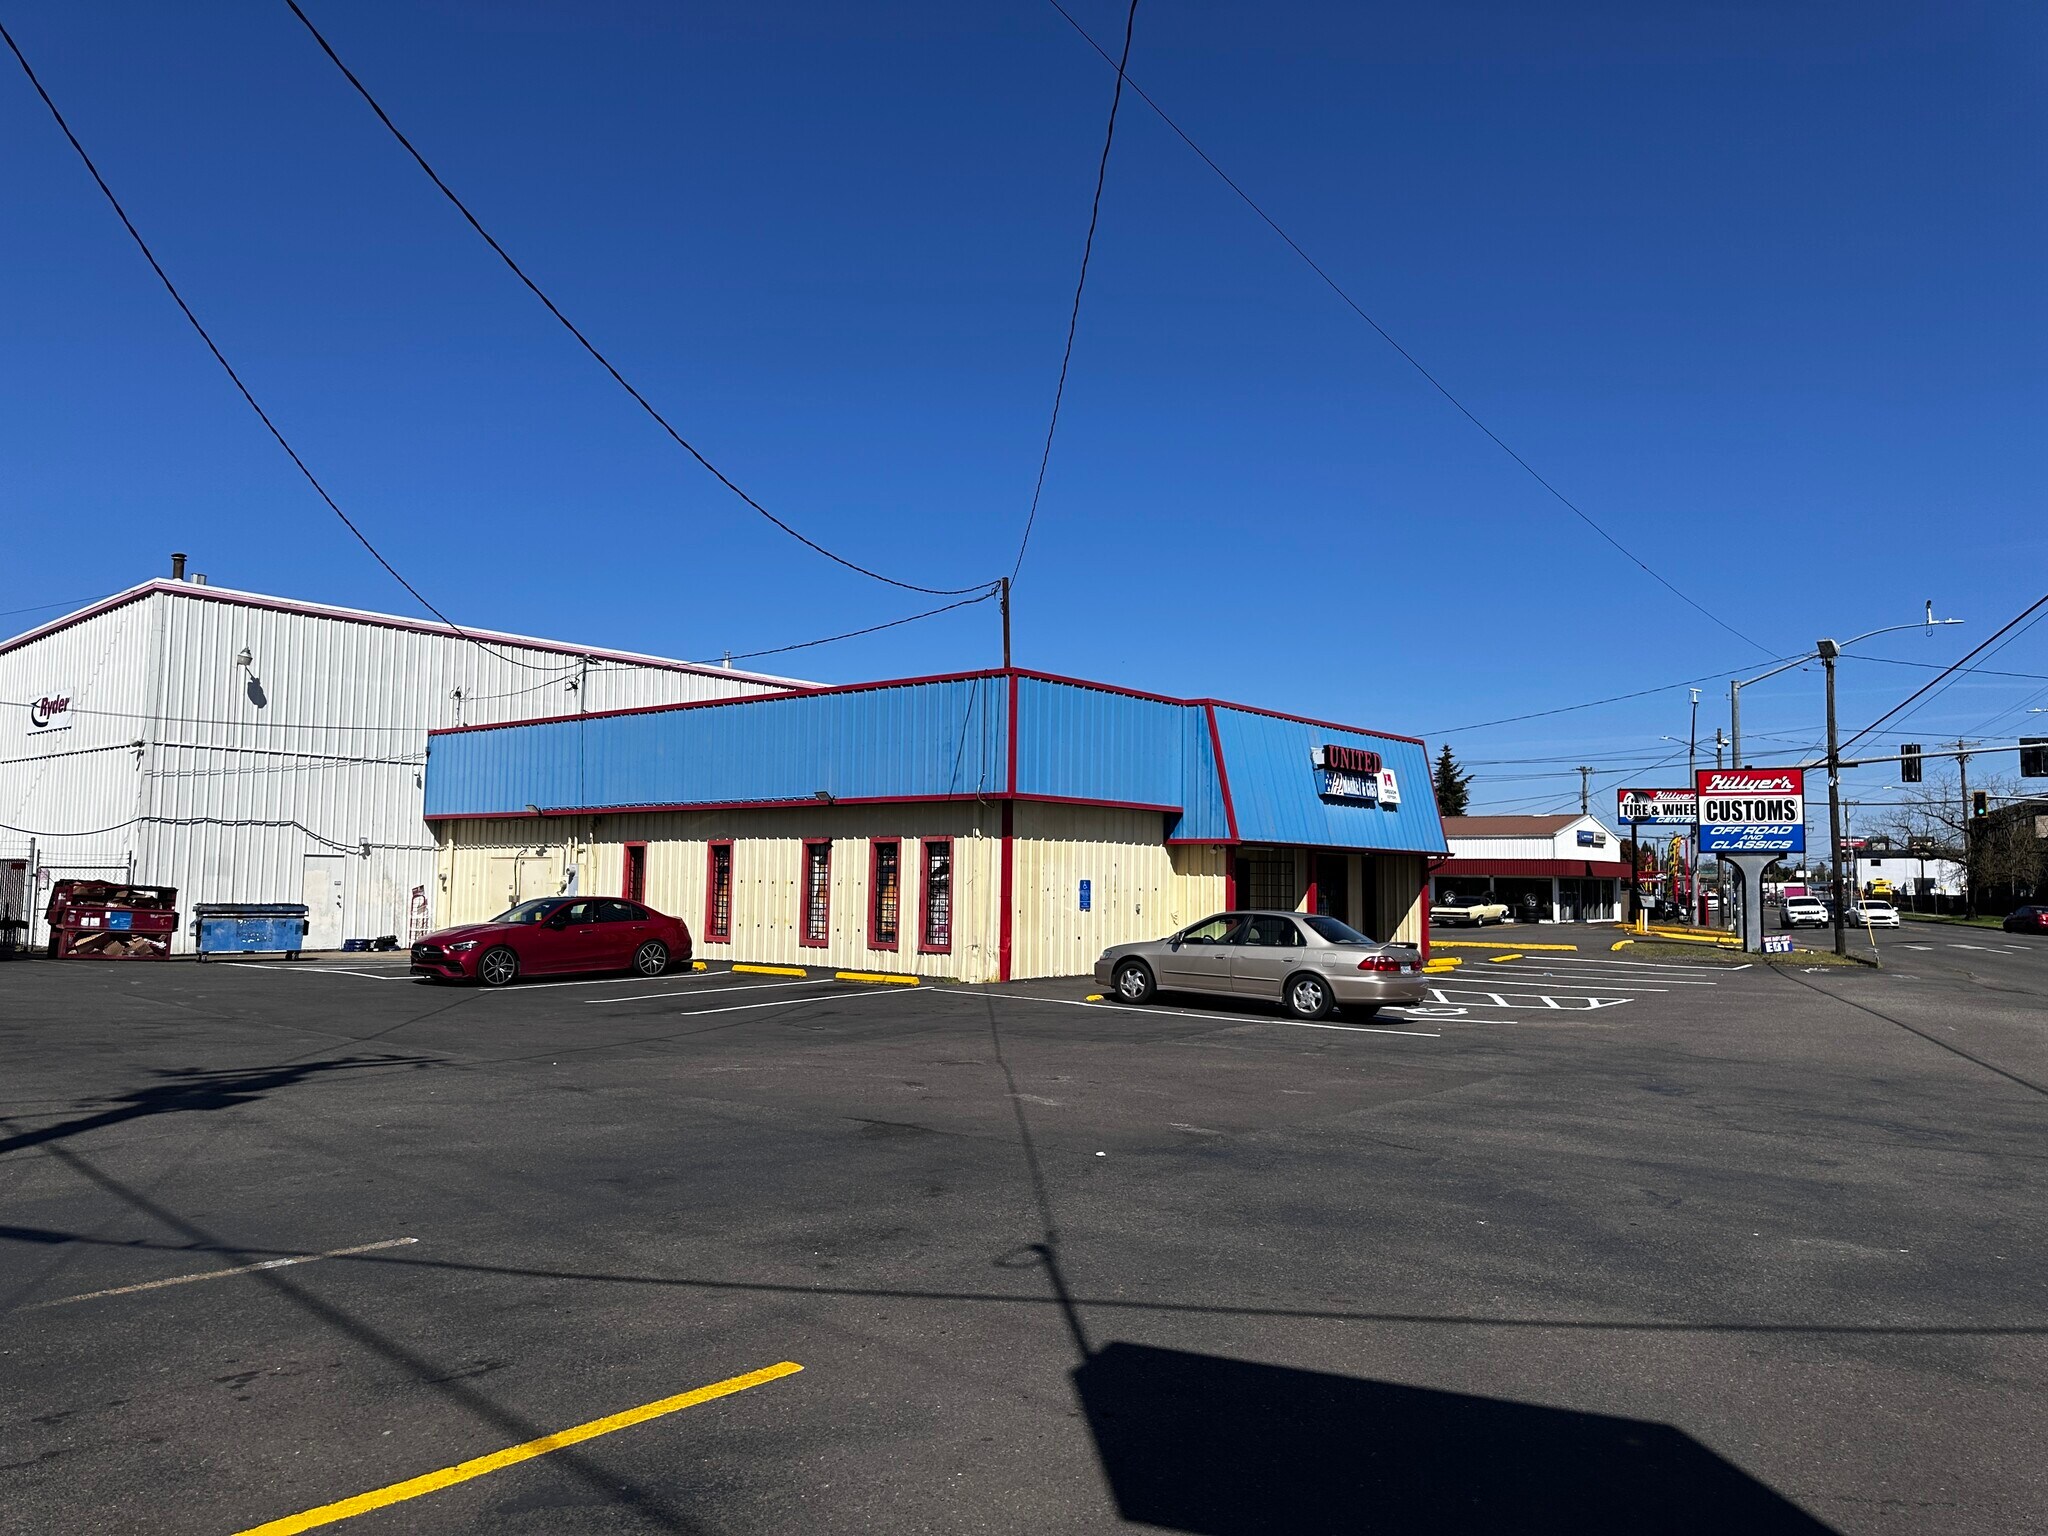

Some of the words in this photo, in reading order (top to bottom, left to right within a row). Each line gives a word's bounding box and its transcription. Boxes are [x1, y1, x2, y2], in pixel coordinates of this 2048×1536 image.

[40, 694, 70, 720] Ryder
[1329, 745, 1382, 773] UNITED
[1705, 774, 1795, 791] Hillyer's
[1653, 791, 1696, 800] Hillyer
[1622, 804, 1648, 816] TIRE
[1651, 806, 1660, 816] &
[1662, 804, 1696, 816] WHEE
[1706, 800, 1796, 821] CUSTOMS
[1710, 826, 1744, 835] OFF
[1743, 826, 1793, 835] ROAD
[1710, 841, 1793, 849] CLASSICS
[1765, 941, 1790, 953] EBT
